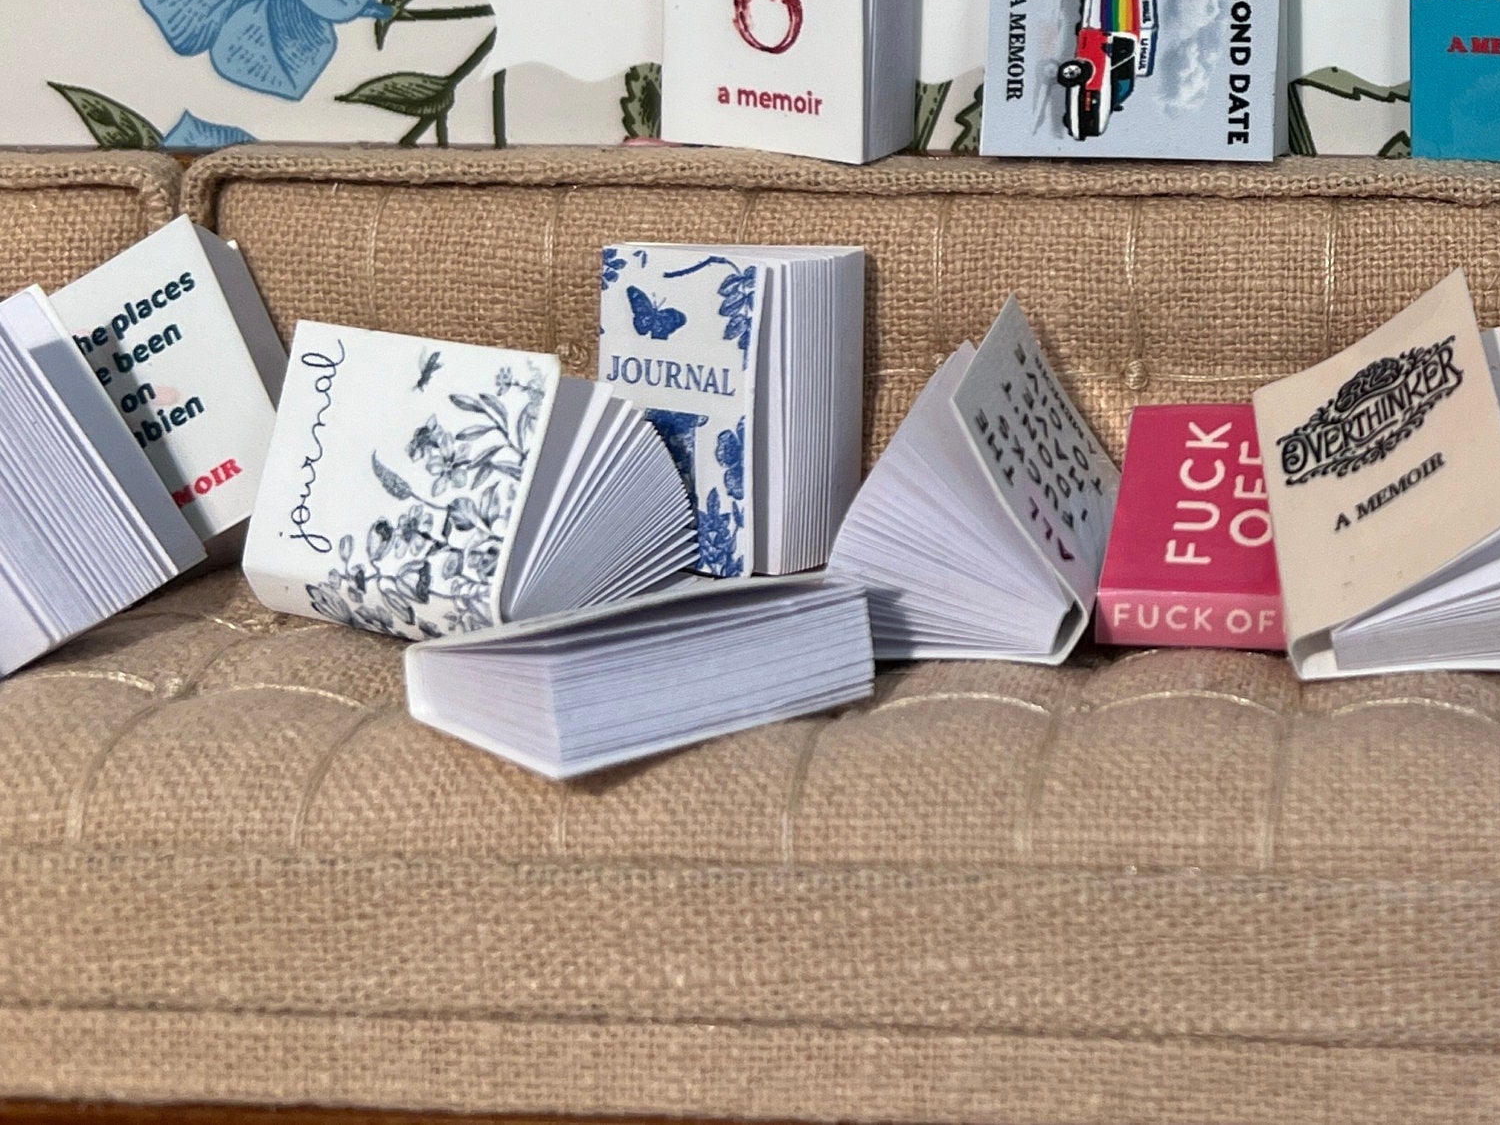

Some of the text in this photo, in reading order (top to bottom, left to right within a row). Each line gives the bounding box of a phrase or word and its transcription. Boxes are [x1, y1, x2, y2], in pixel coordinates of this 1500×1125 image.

[1006, 12, 1025, 102] MEMOIR
[1447, 36, 1466, 53] A
[717, 87, 823, 117] a memoir
[1227, 75, 1251, 147] DATE
[73, 271, 195, 355] he places
[113, 324, 182, 373] been
[607, 356, 736, 397] JOURNAL
[1281, 345, 1463, 474] OVERTHINKER
[133, 395, 205, 449] bien
[279, 339, 345, 553] journal
[1014, 343, 1102, 495] TO GIVE
[1023, 386, 1085, 492] HAVE
[975, 408, 1075, 562] ALL THE
[1000, 415, 1074, 530] FUCKS
[1165, 421, 1234, 564] FUCK
[1334, 452, 1446, 532] A MEMOIR
[1113, 604, 1286, 634] FUCK OF
